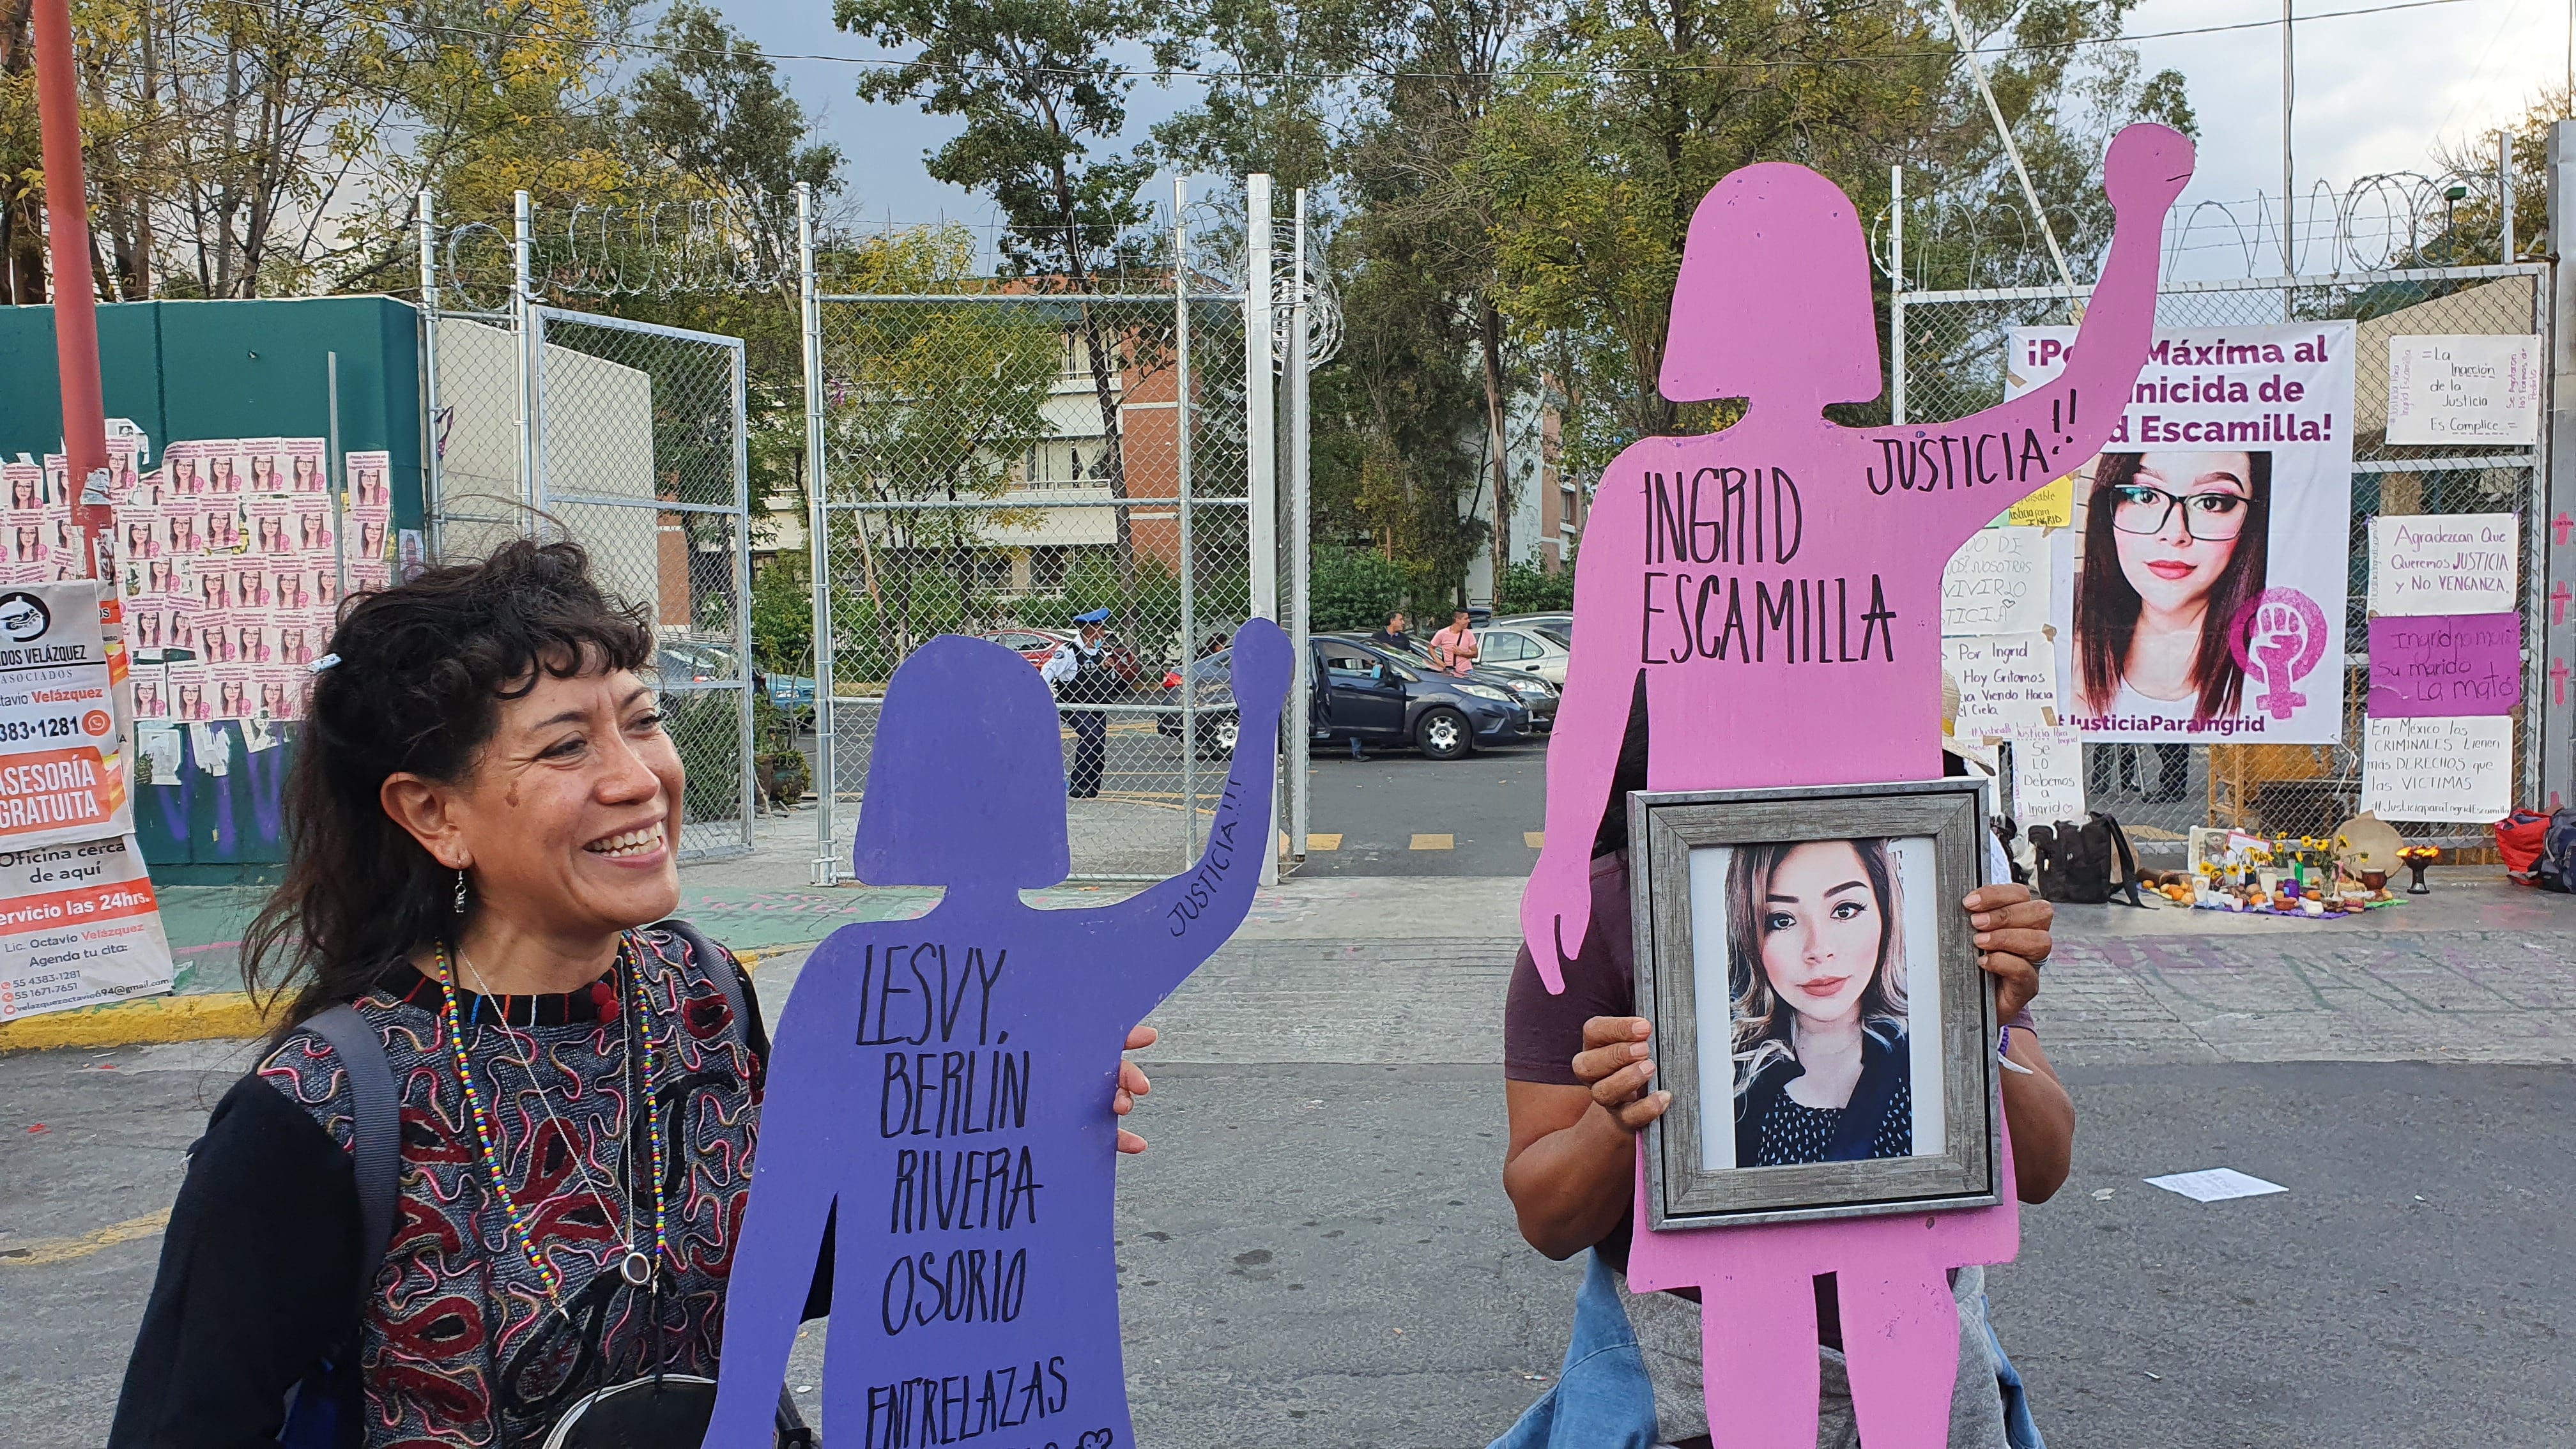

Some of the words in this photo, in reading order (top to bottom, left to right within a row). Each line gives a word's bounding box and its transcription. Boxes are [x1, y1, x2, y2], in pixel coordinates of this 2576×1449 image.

[2294, 335, 2328, 363] al
[2128, 374, 2248, 403] nicida
[2258, 374, 2304, 403] de
[2430, 379, 2445, 392] de
[2450, 378, 2462, 391] la
[2442, 394, 2488, 408] Justicia
[2141, 413, 2331, 443] Escamilla!
[1642, 467, 1802, 565] INGRID
[1998, 535, 2023, 555] DE
[2394, 524, 2474, 553] Agradezcan
[2481, 526, 2506, 542] Que
[2391, 554, 2450, 570] Queremos
[2453, 551, 2509, 572] JUSTICIA
[1641, 572, 1896, 664] ESCAMILLA
[24, 644, 88, 664] VELÁZQUEZ
[1959, 643, 1981, 661] Por
[1992, 641, 2028, 664] Ingrid
[1, 670, 73, 684] ASOCIADOS
[1963, 669, 1988, 687] Hoy
[1993, 668, 2045, 683] Gritamos
[31, 688, 103, 703] Velázquez
[1981, 689, 2019, 701] Viendo
[2025, 688, 2053, 700] Hacia
[2372, 718, 2390, 736] En
[2399, 717, 2440, 737] México
[2030, 740, 2050, 756] Se
[2374, 738, 2453, 752] CRIMINALES
[2023, 772, 2075, 788] Debemos
[2372, 776, 2393, 792] las
[0, 790, 100, 829] GRATUITA
[0, 848, 72, 867] Oficina
[77, 843, 126, 857] cerca
[29, 868, 54, 883] de
[59, 861, 101, 880] aquí
[0, 903, 62, 926] ervicio
[66, 900, 95, 916] las
[99, 892, 151, 910] 24hrs.
[5, 942, 26, 953] Lic.
[29, 934, 78, 949] Octavio
[81, 924, 144, 940] Velázquez
[29, 952, 80, 968] Agenda
[84, 948, 98, 958] tu
[101, 944, 128, 955] cita:
[13, 979, 26, 988] 55
[855, 942, 1007, 1047] LESVY
[15, 990, 28, 1000] 55
[891, 1146, 1045, 1235] RIVERA
[882, 1249, 1026, 1336] OSORIO
[865, 1356, 1068, 1449] ENTRELAZAS
